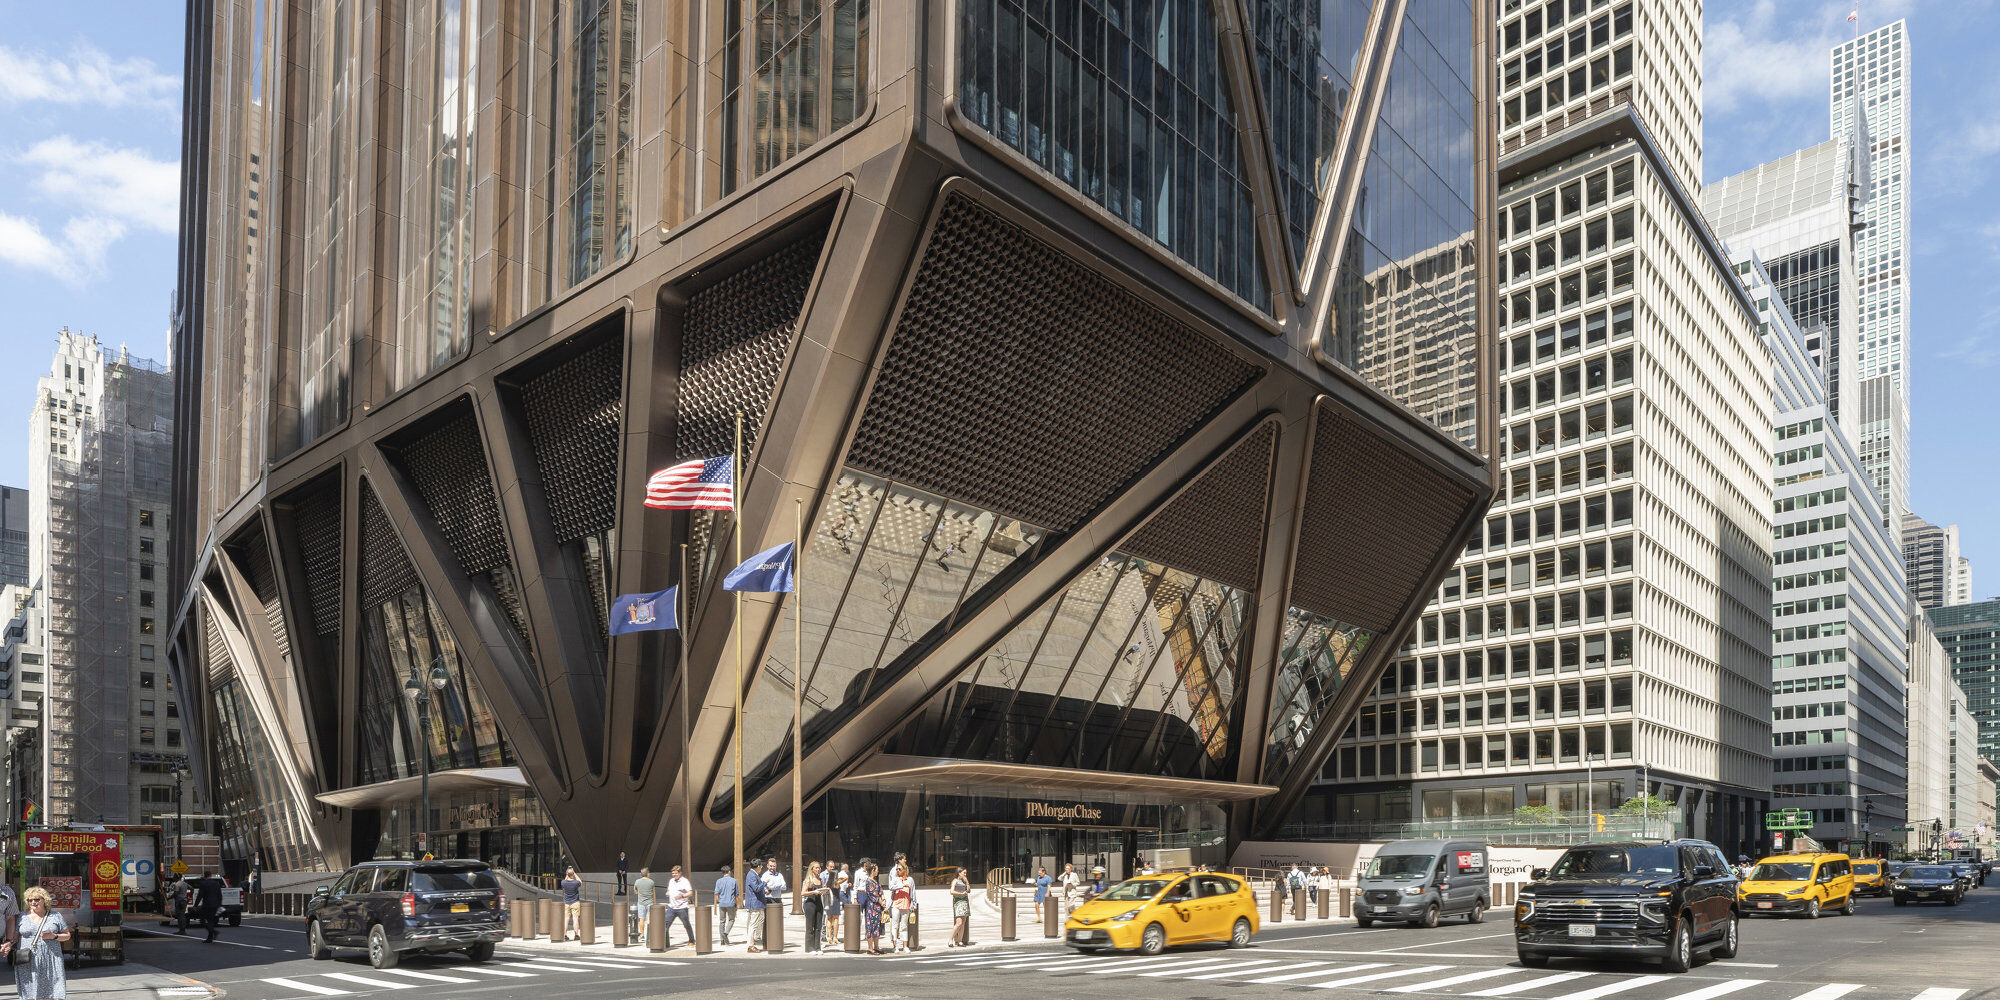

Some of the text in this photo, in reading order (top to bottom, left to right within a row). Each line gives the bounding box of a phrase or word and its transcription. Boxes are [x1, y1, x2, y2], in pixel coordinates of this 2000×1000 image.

[1026, 802, 1102, 820] JPMorganChase
[50, 834, 97, 844] Bismilla
[43, 843, 72, 852] Halal
[75, 843, 103, 852] Food
